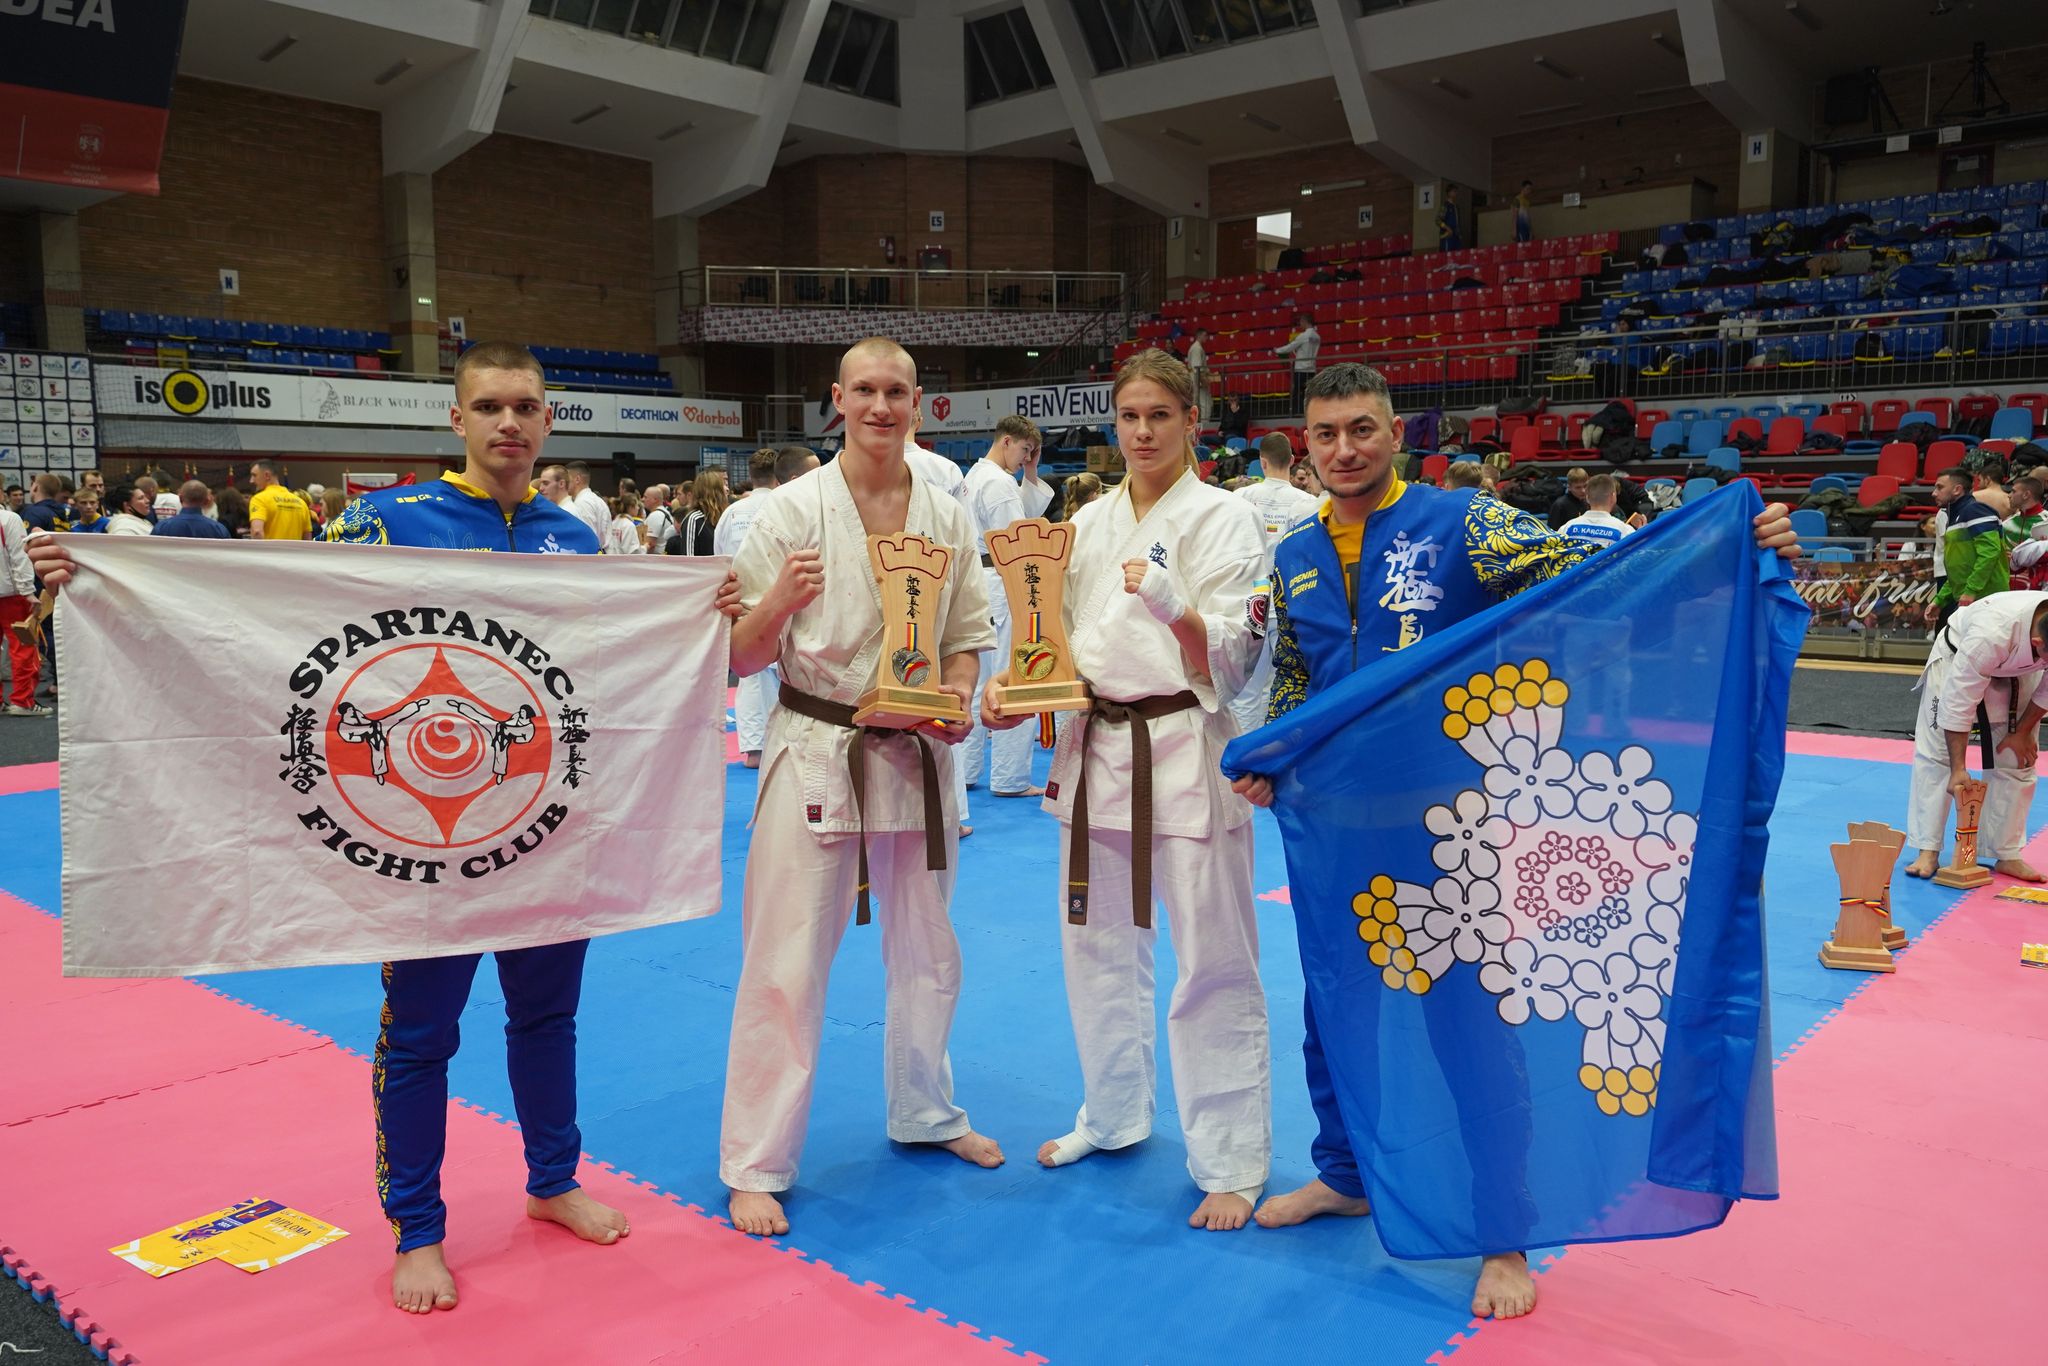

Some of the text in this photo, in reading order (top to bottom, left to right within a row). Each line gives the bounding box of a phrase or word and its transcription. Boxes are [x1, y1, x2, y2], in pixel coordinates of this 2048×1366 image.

[1753, 141, 1762, 155] H
[224, 276, 233, 289] N
[343, 395, 382, 407] BLACK
[388, 397, 420, 409] WOLF
[1016, 387, 1112, 418] BENVENU
[550, 401, 593, 421] lotto
[621, 408, 679, 422] DECATHLON
[695, 410, 740, 426] dorbob
[945, 419, 977, 429] advertising
[1069, 414, 1115, 424] www.benvenu
[289, 607, 575, 700] SPARTANEC
[297, 803, 569, 884] FIGHT CLUB
[270, 1216, 312, 1237] DIPLOMA
